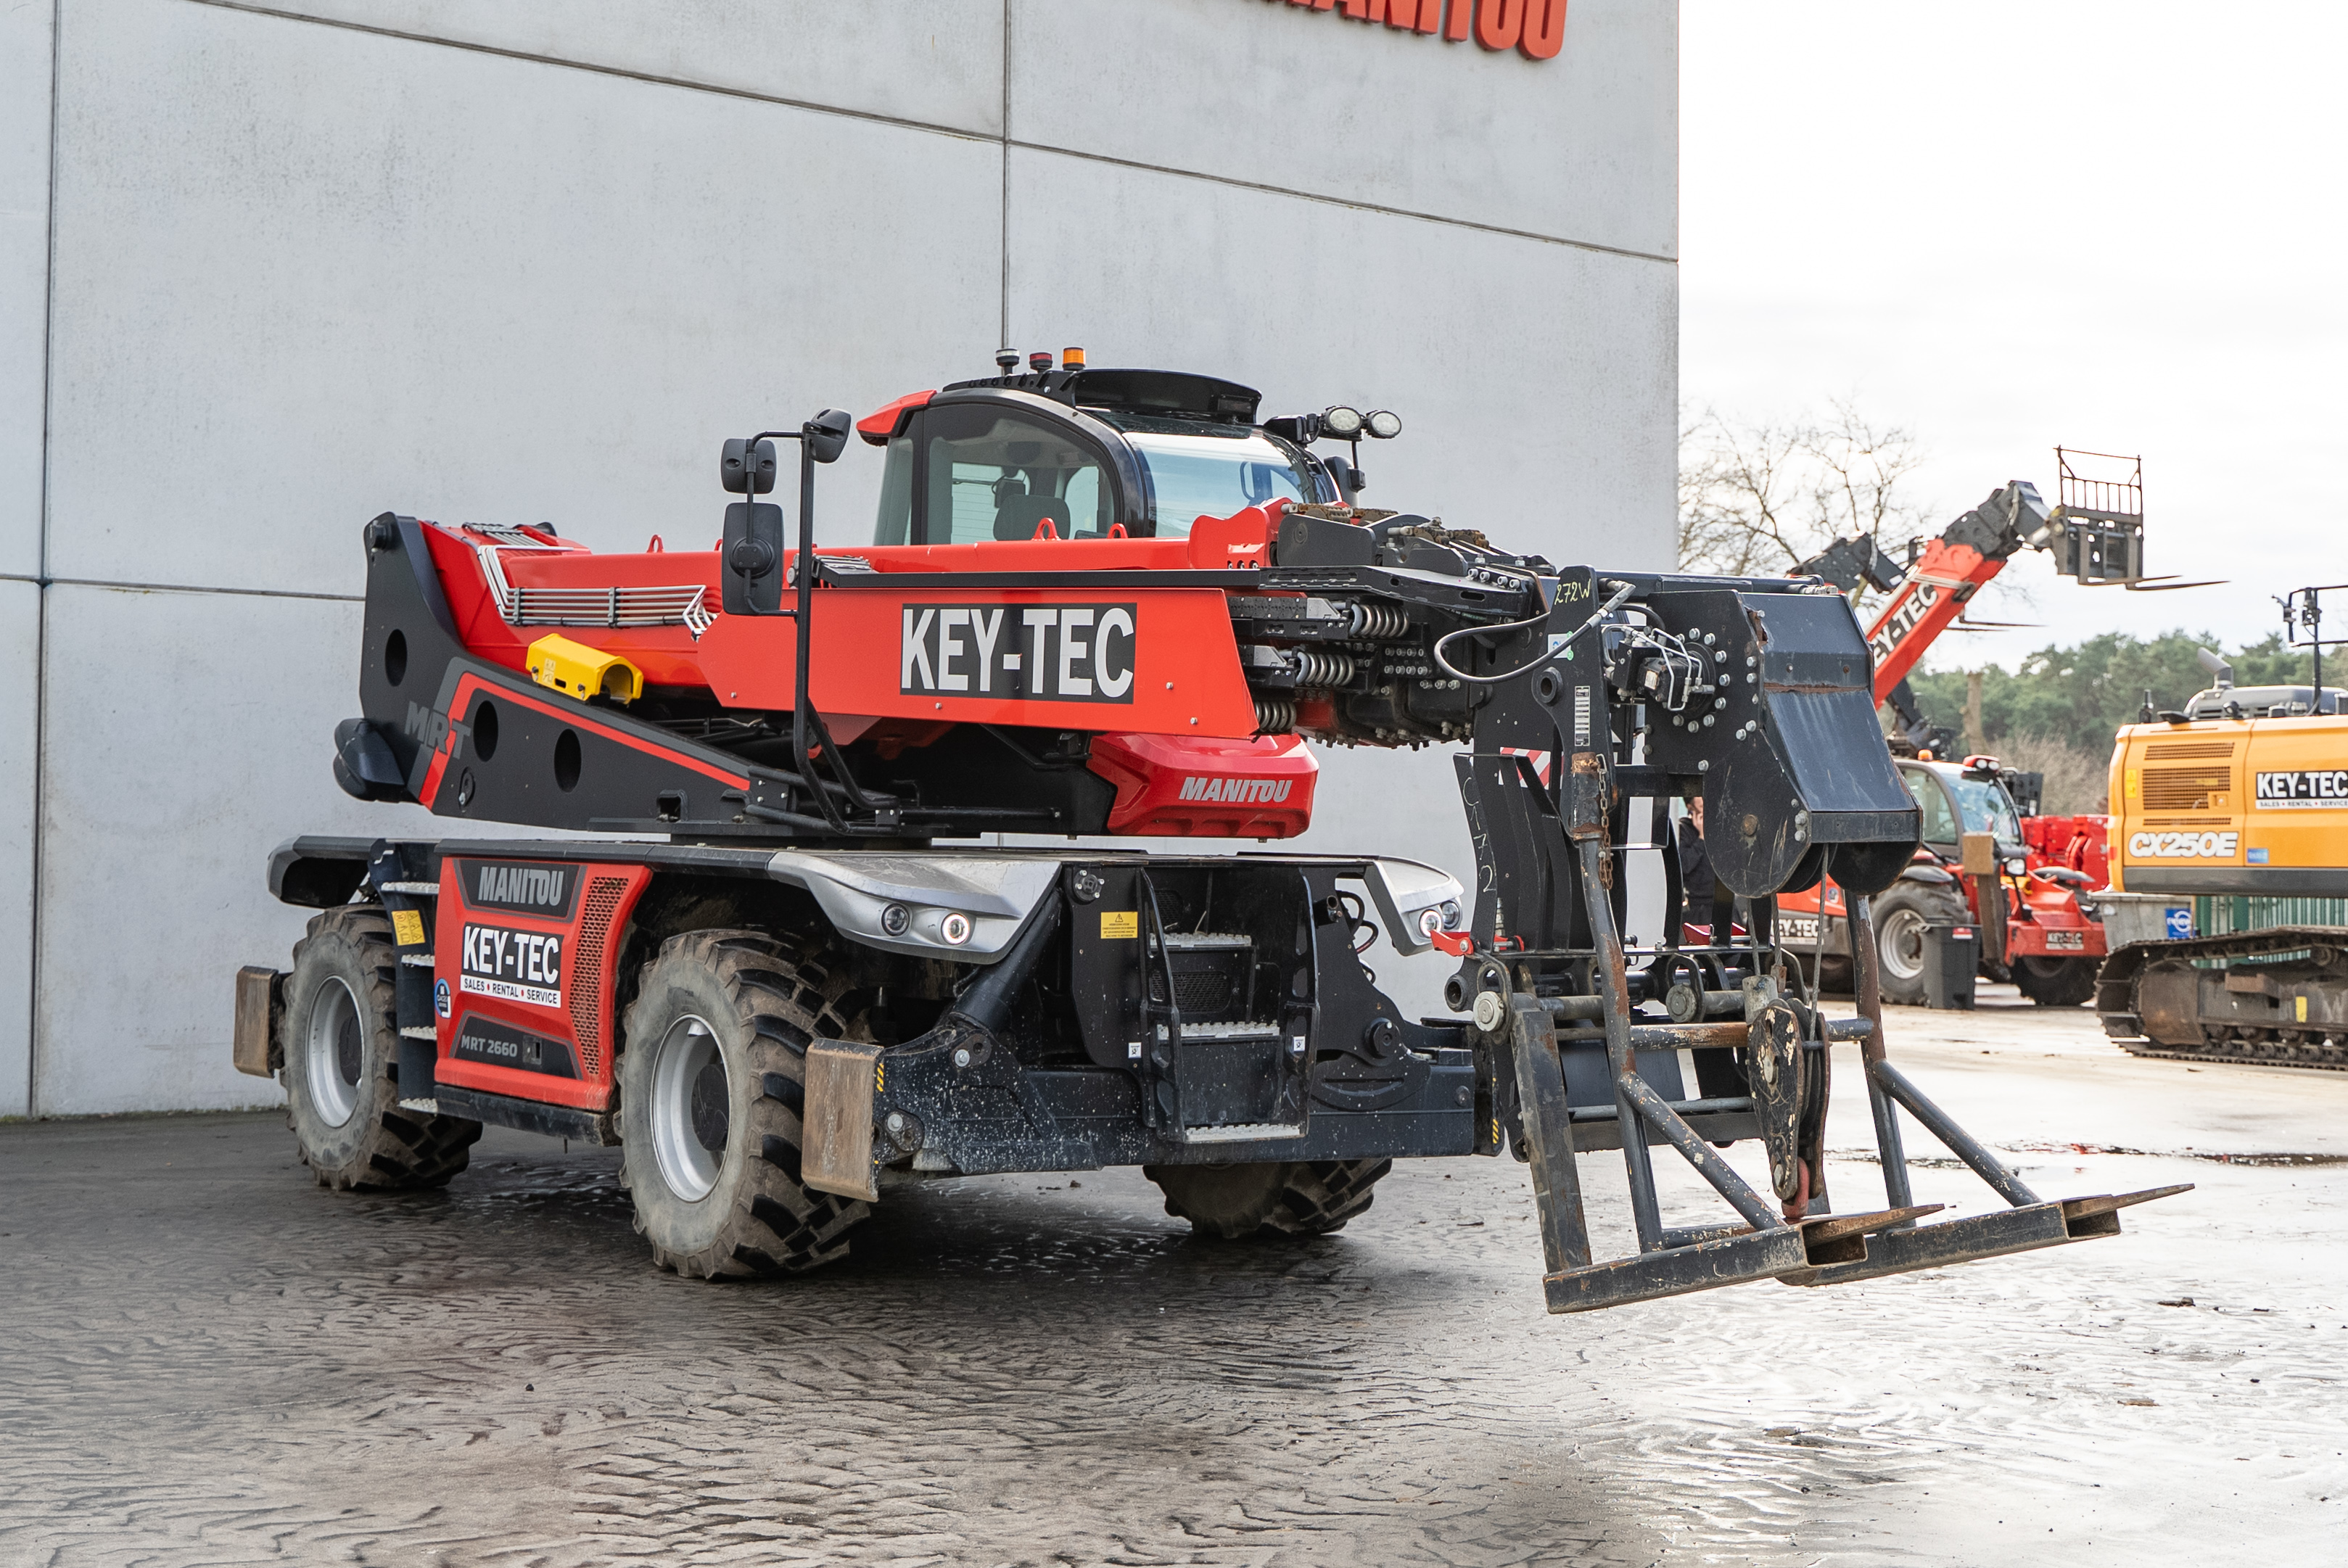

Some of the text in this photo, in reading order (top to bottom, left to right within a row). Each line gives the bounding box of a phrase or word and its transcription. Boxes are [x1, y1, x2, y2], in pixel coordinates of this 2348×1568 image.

[1554, 578, 1591, 606] 272W
[1873, 582, 1938, 672] EY-TEC
[901, 607, 1134, 698] KEY-TEC
[404, 700, 471, 760] MRT
[1178, 776, 1293, 803] MANITOU
[2257, 771, 2348, 798] KEY-TEC
[2128, 830, 2239, 858] CX250E
[477, 866, 564, 906] MANITOU
[463, 925, 559, 984] KEY-TEC
[464, 978, 557, 1004] SALES RENTAL SERVICE
[461, 1034, 517, 1057] MRT 2660
